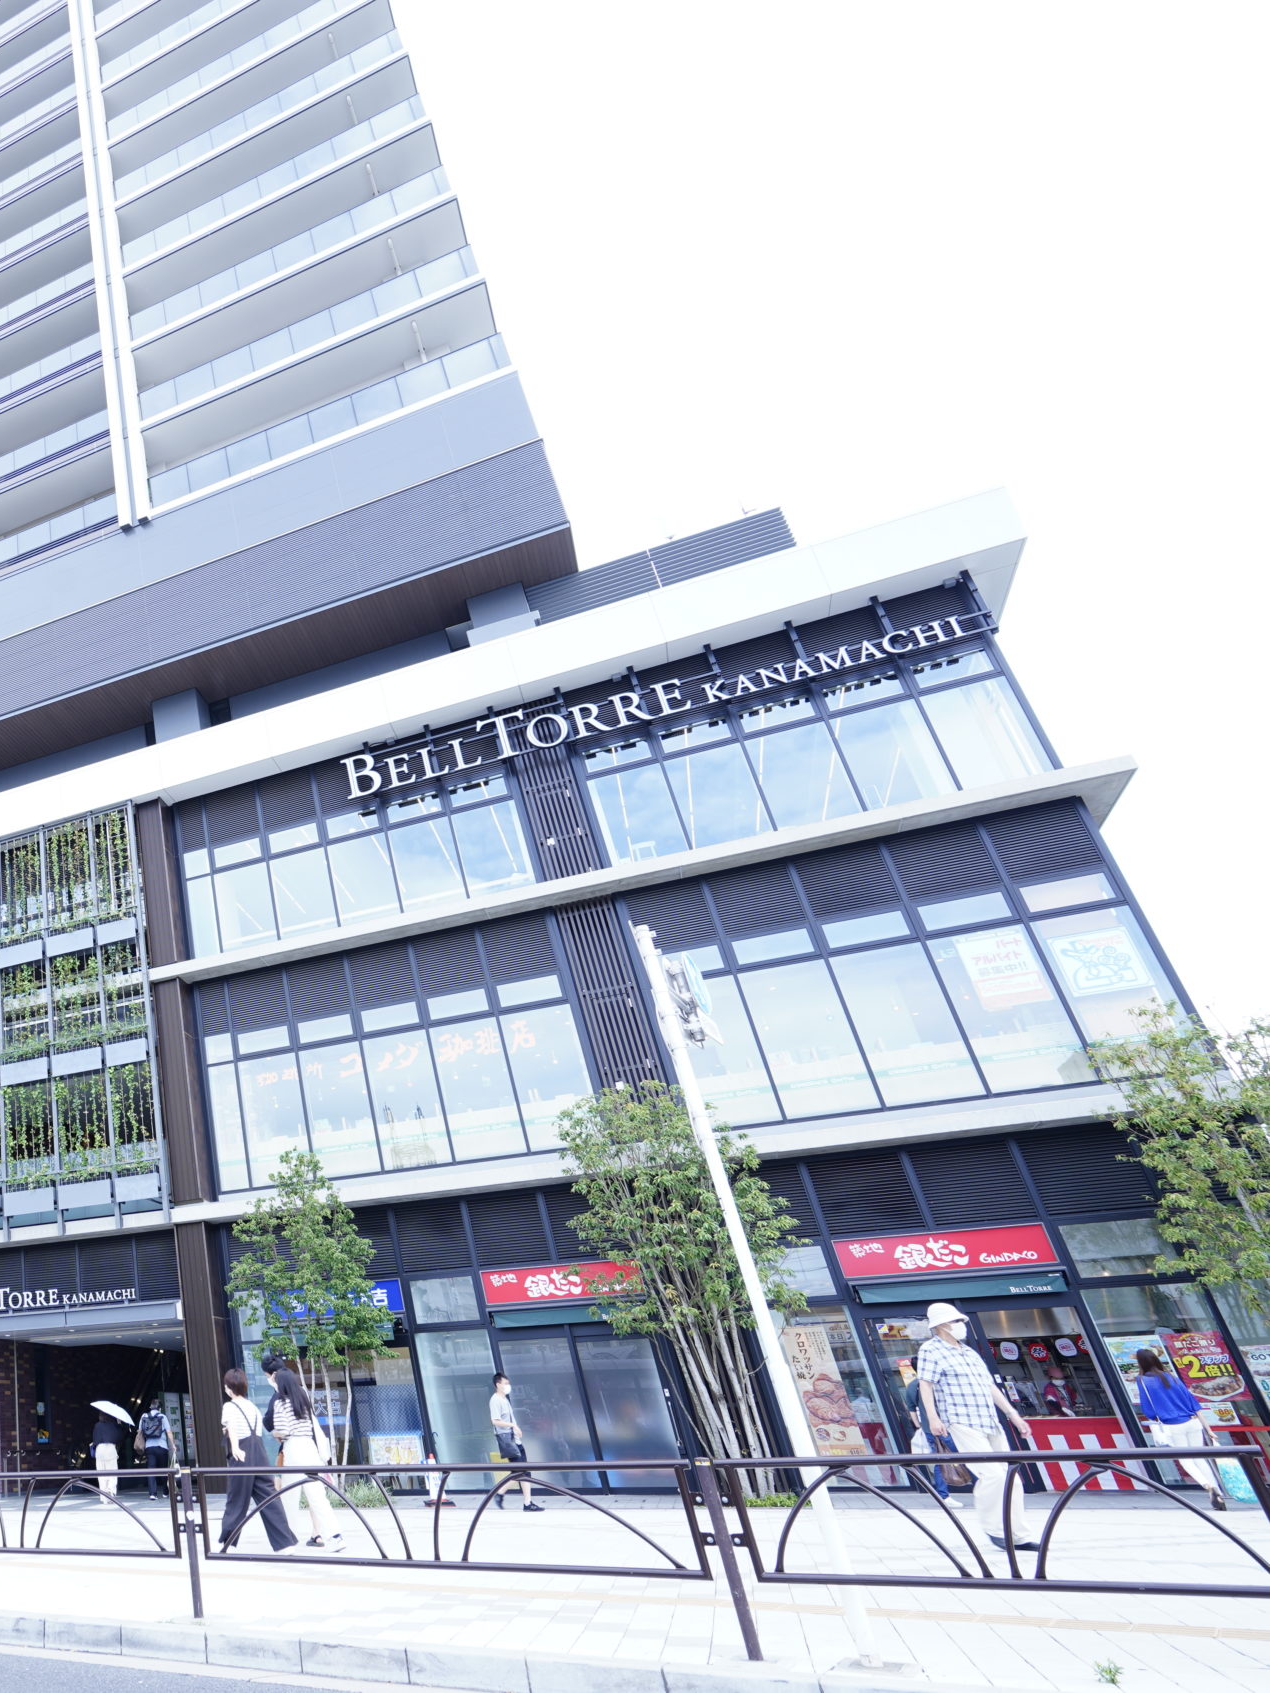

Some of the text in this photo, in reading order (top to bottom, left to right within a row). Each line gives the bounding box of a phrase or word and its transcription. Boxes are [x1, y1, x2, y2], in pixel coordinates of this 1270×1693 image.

[704, 616, 969, 704] KANAMACHI
[970, 950, 1023, 966] アルバイト
[849, 1237, 1039, 1270] 築地 銀だこ GINDACO
[489, 1273, 518, 1287] 築地
[62, 1288, 136, 1305] KANAMACHI
[794, 1331, 815, 1380] クロワッサン
[792, 1356, 807, 1380] たい焼
